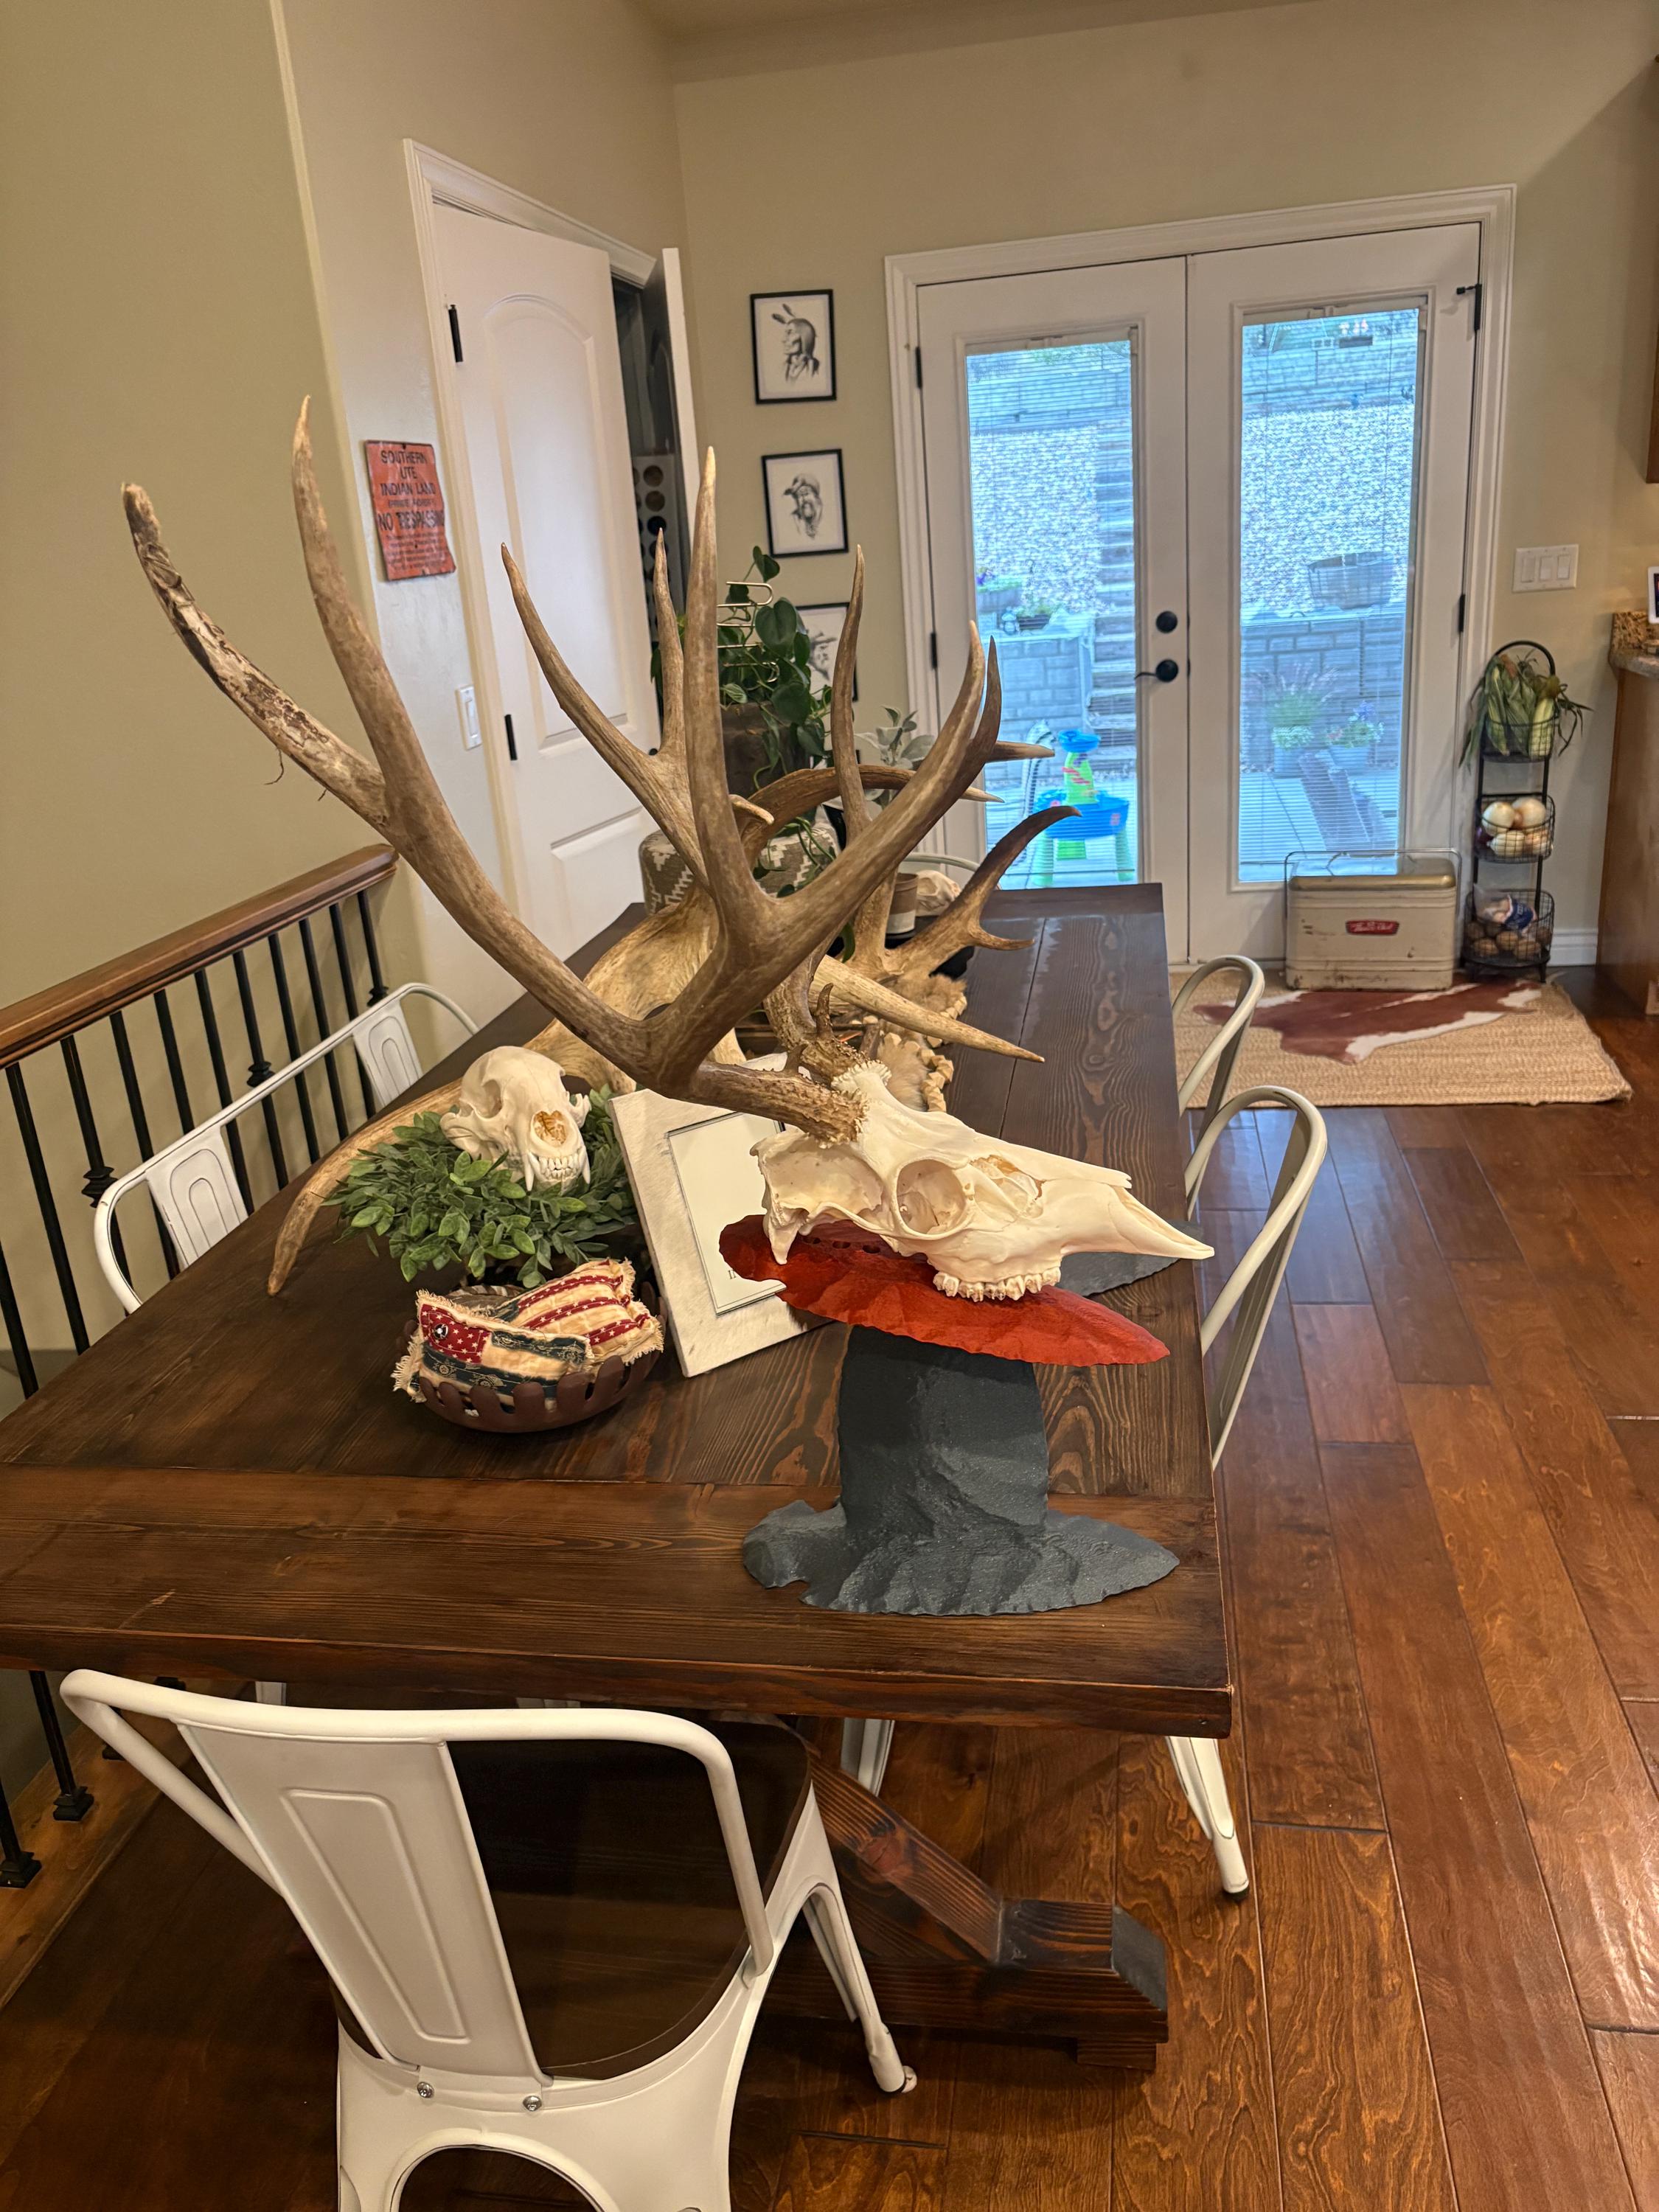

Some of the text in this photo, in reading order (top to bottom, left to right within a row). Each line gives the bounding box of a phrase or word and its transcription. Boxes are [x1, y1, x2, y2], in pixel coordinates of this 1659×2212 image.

[381, 451, 427, 464] SOUTHERN
[400, 467, 417, 479] UTE
[380, 482, 413, 496] INDIAN
[378, 512, 394, 531] NO
